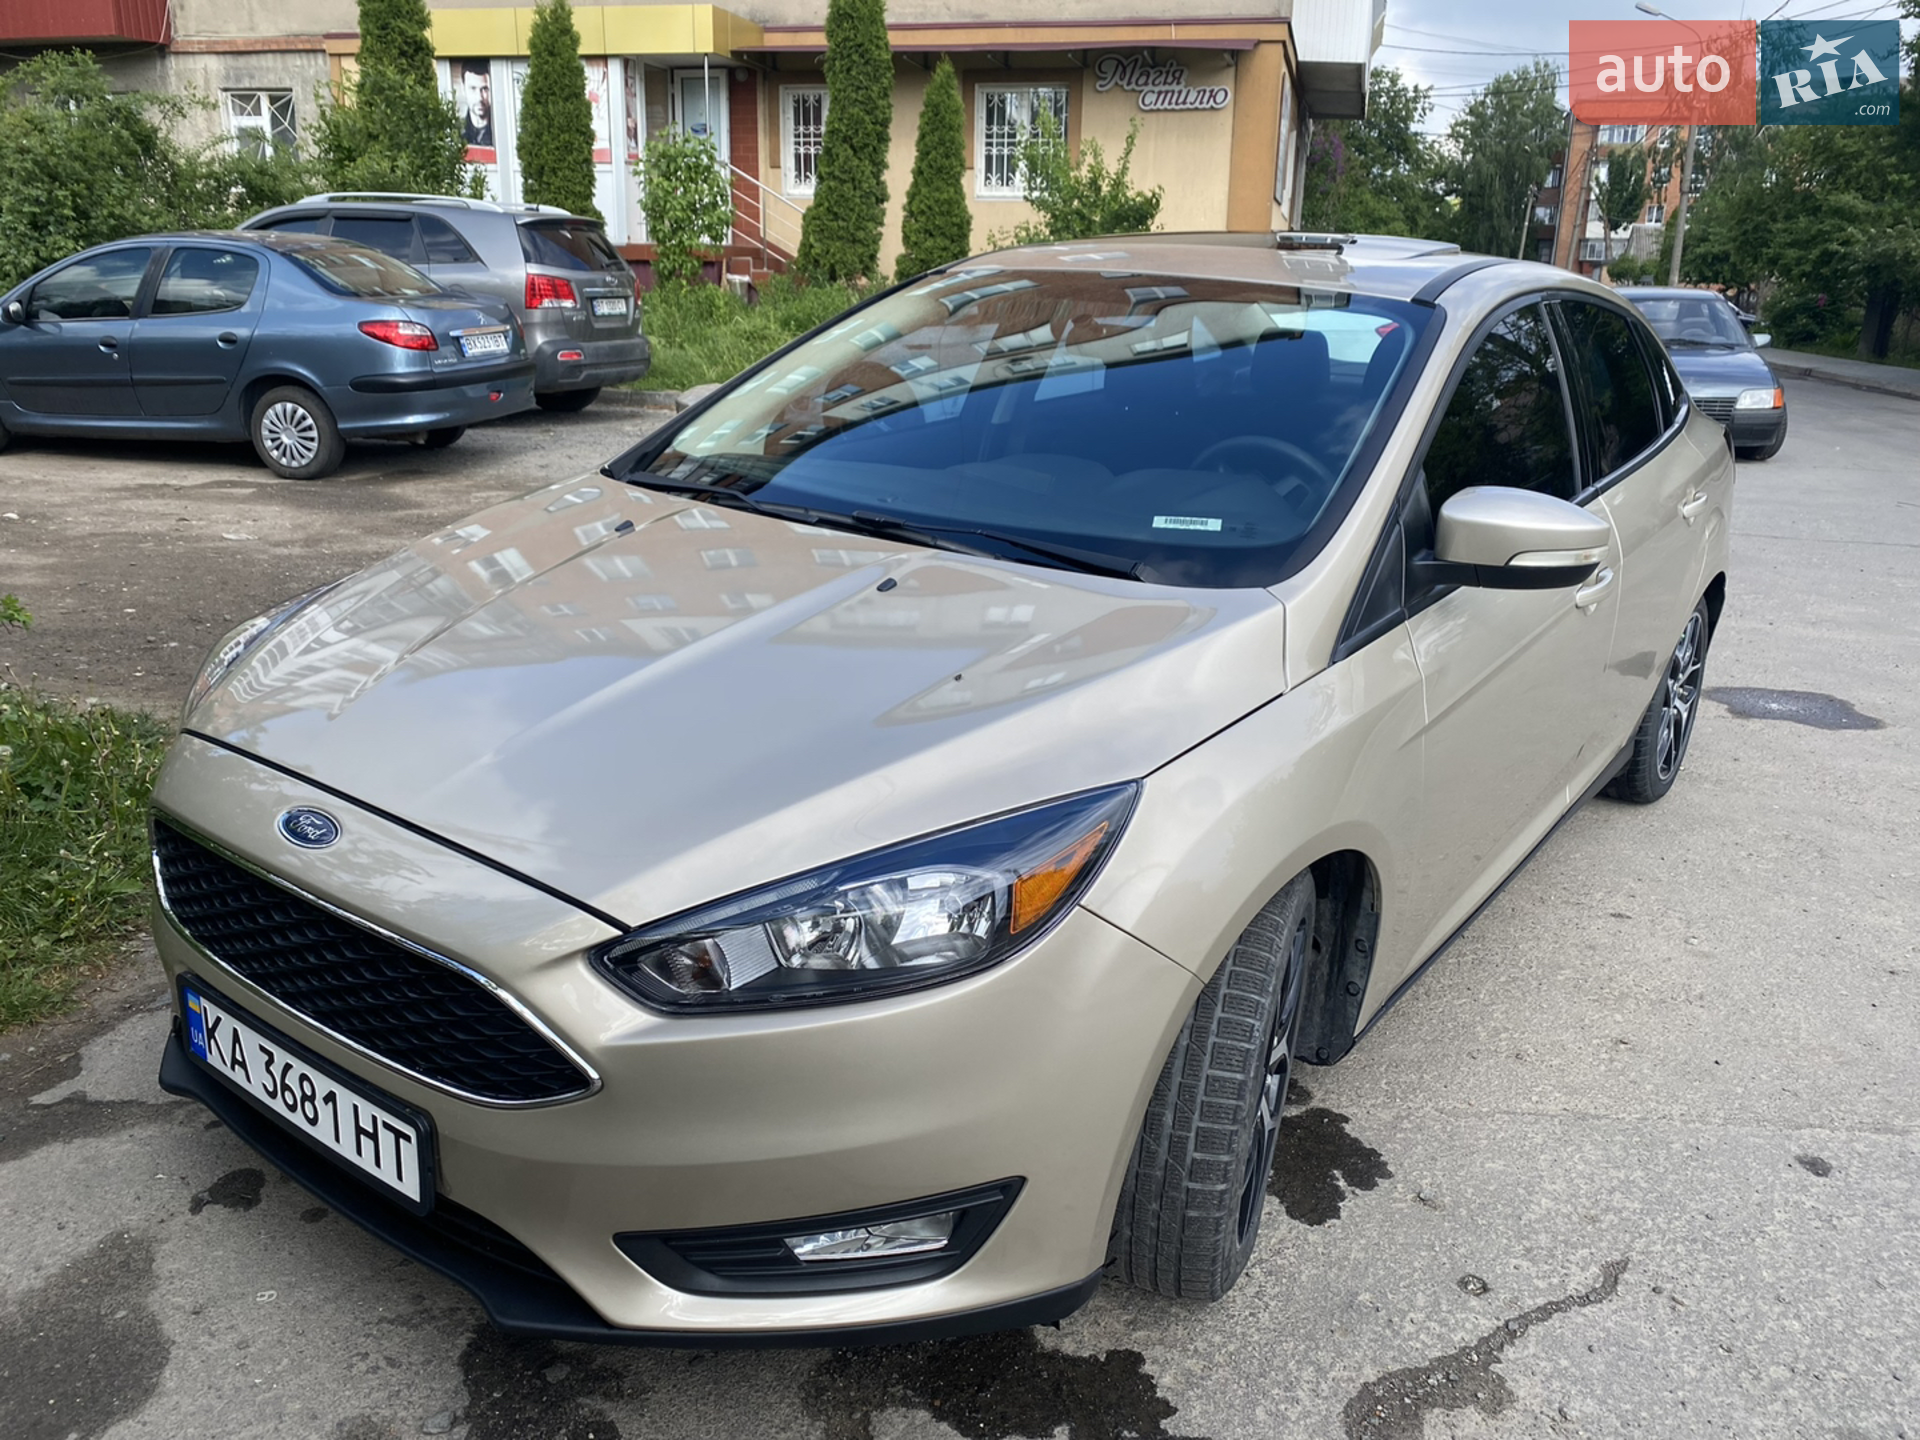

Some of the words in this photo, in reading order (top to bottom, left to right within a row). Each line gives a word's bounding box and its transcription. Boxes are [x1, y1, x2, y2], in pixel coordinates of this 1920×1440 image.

[1097, 54, 1184, 89] Магія
[1141, 87, 1229, 108] стилю
[290, 814, 328, 840] Ford
[191, 1028, 205, 1047] UA
[203, 1004, 252, 1084] KA
[258, 1043, 341, 1144] 3681
[353, 1102, 412, 1183] HT
